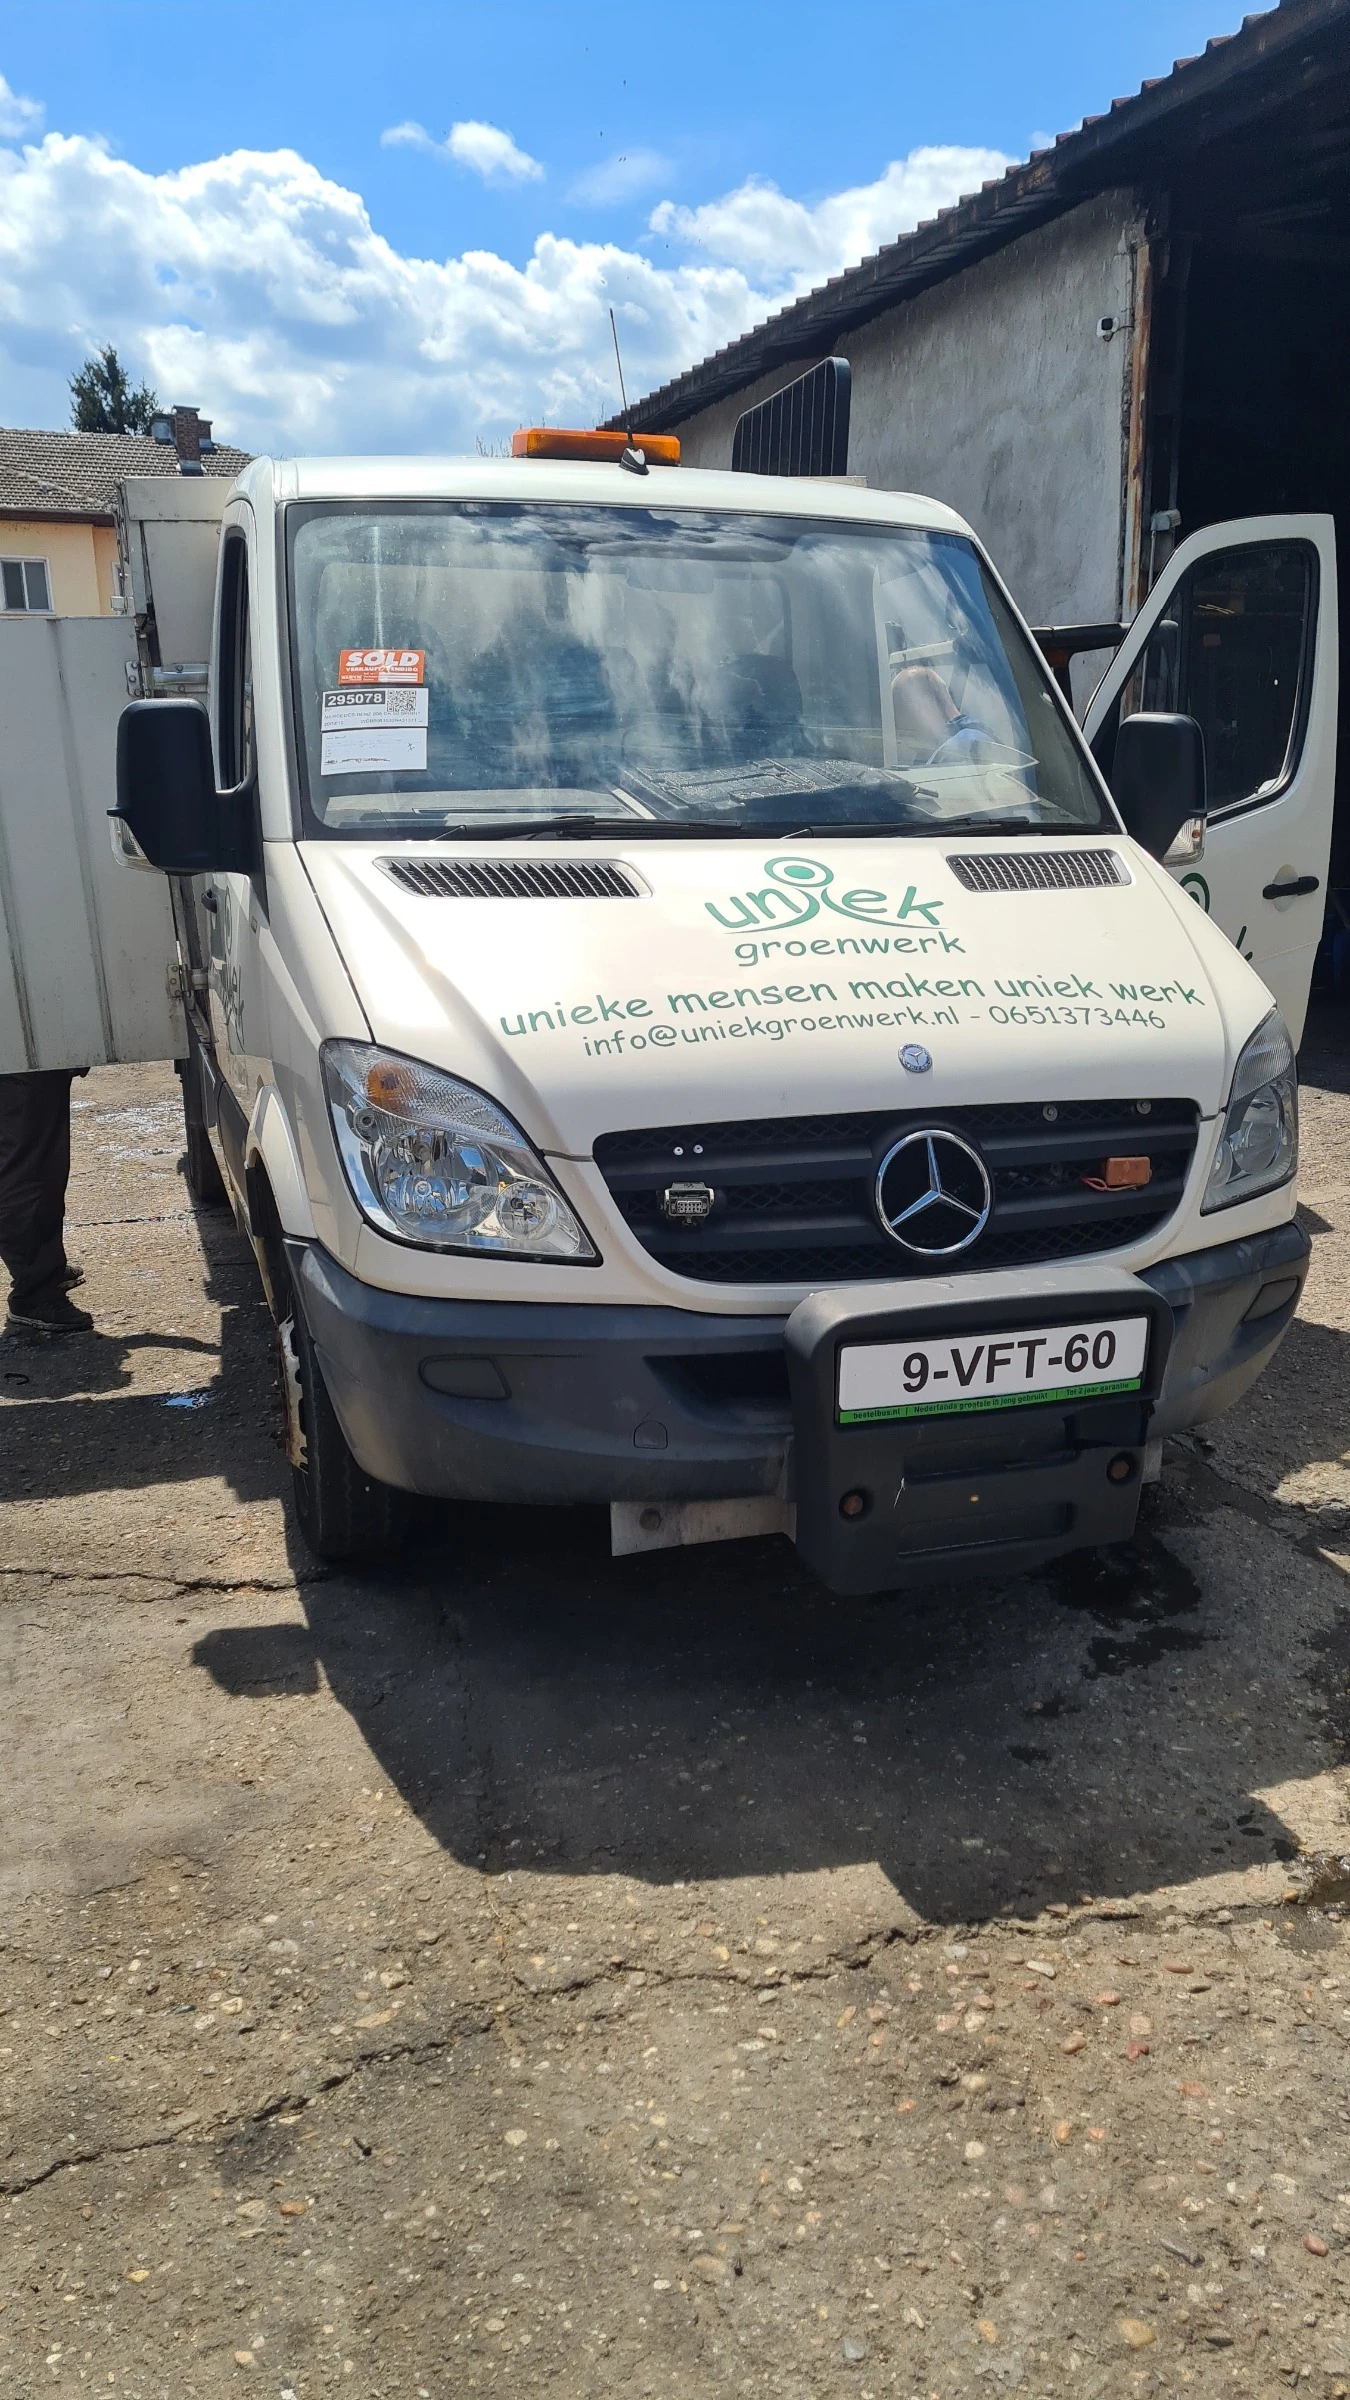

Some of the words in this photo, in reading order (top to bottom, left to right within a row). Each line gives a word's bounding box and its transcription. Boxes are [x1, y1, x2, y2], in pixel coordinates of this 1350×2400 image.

[345, 651, 420, 667] SOLD
[327, 693, 383, 706] 295078
[704, 856, 946, 934] uniek
[734, 931, 967, 967] groenwerk
[499, 994, 653, 1036] unieke
[667, 980, 838, 1014] mensen
[848, 972, 985, 1000] maken
[994, 973, 1103, 999] uniek
[1109, 980, 1205, 1006] werk
[583, 1005, 960, 1056] info@uniekgroenwerk.nl
[989, 1005, 1166, 1029] 0651373446
[901, 1329, 1117, 1394] 9-VFT-60
[853, 1408, 901, 1420] bestelbus.nl
[1000, 1395, 1016, 1406] jong
[1017, 1392, 1048, 1404] gebruikt
[1066, 1389, 1077, 1397] Tot
[1084, 1386, 1098, 1397] jaar
[1099, 1382, 1129, 1394] garantie
